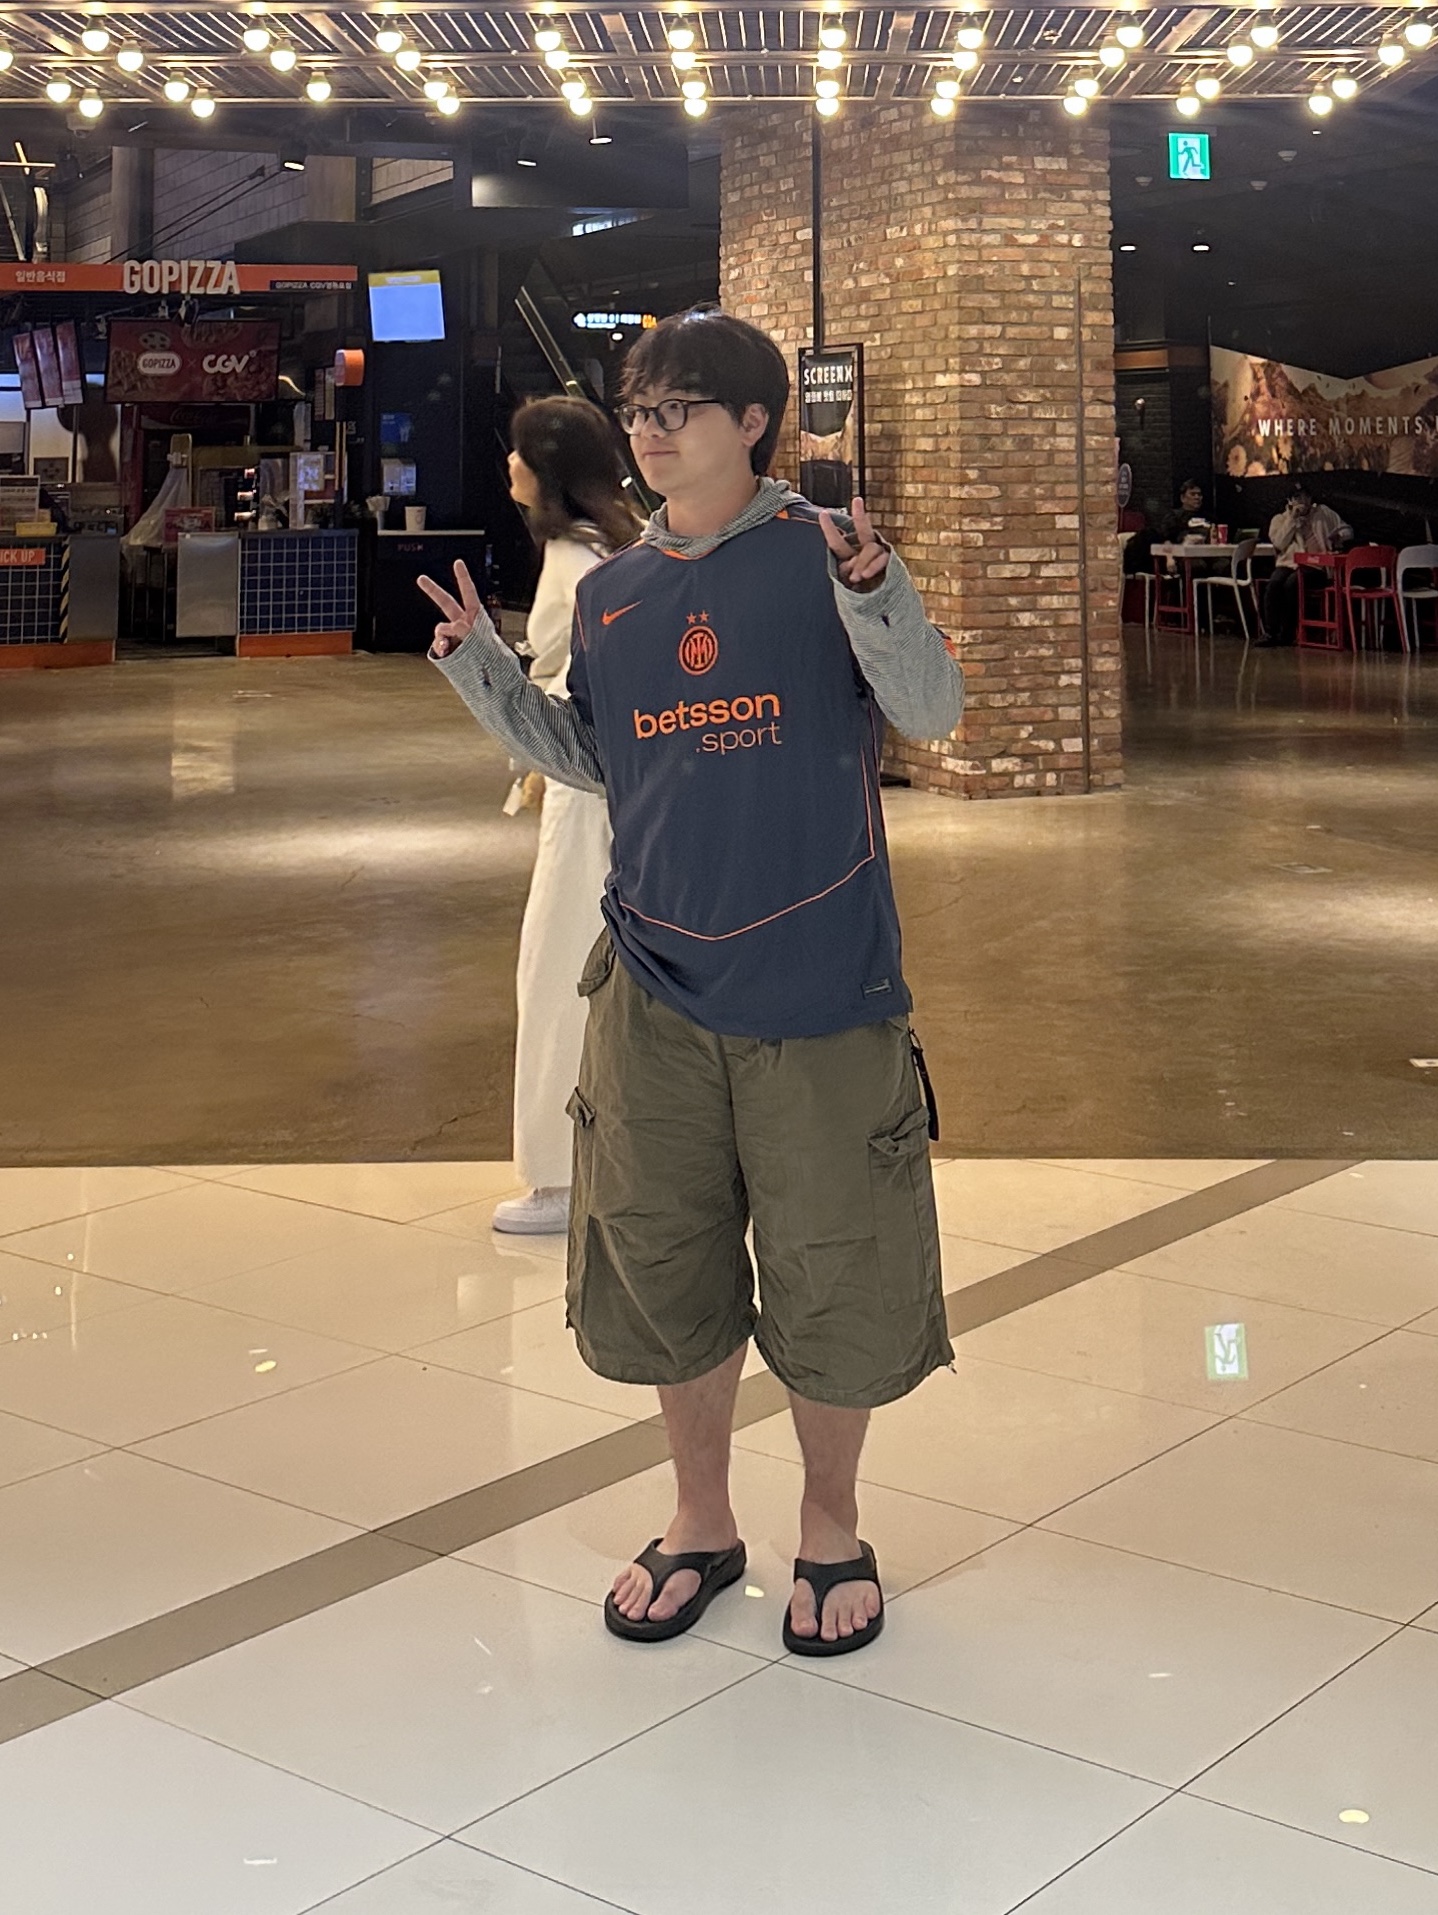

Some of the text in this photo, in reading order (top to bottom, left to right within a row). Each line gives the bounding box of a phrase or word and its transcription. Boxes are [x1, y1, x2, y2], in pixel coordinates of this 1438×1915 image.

[15, 270, 66, 283] 일반음식점
[123, 260, 240, 295] GOPIZZA
[142, 354, 250, 374] GOPIZZA CGV
[803, 364, 853, 386] SCREENX
[1257, 418, 1317, 437] WHERE
[1328, 415, 1423, 435] MOMENTS
[21, 549, 35, 563] UP
[633, 693, 781, 739] betsson
